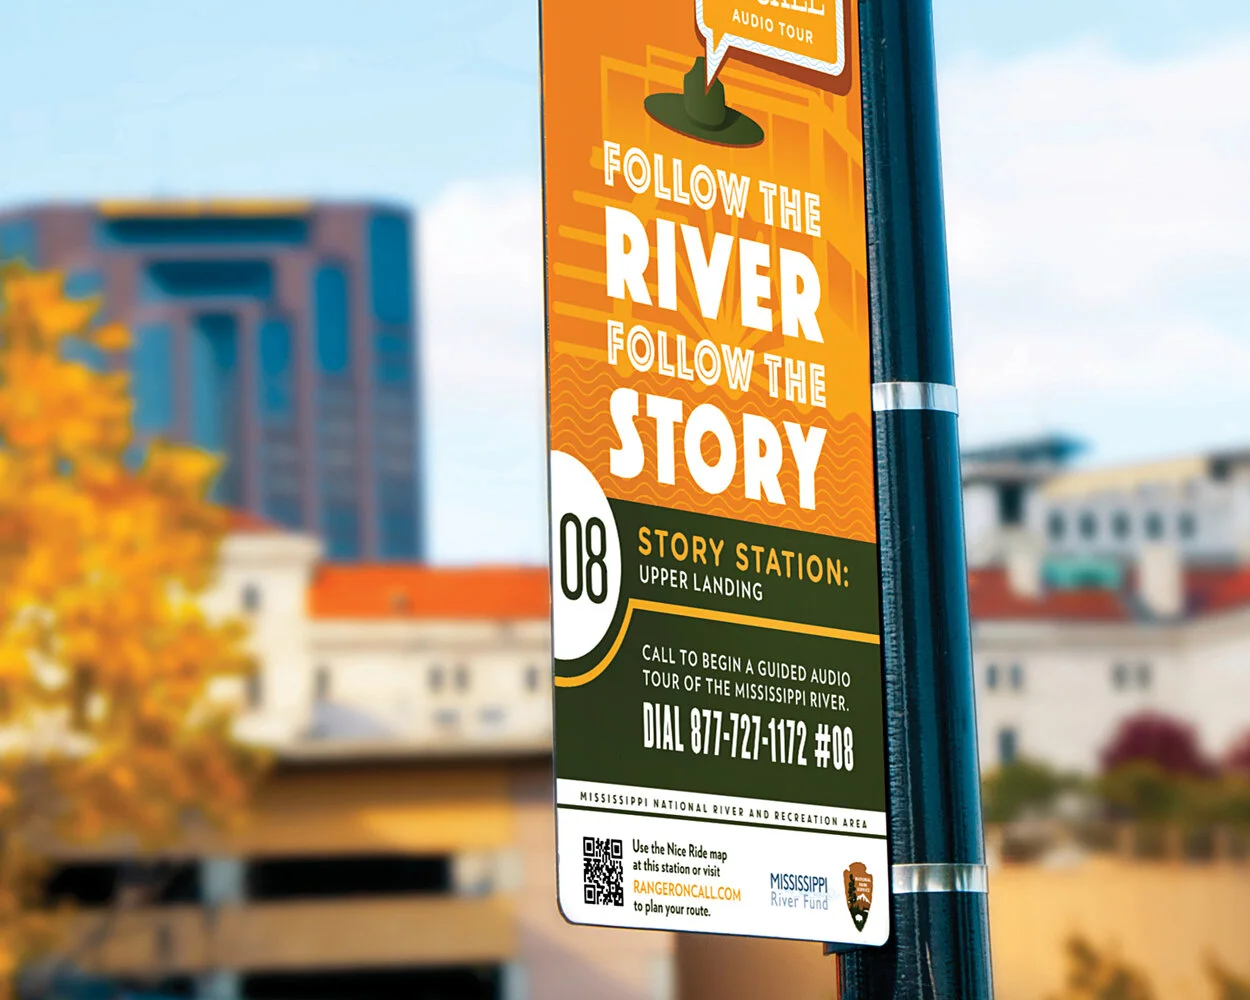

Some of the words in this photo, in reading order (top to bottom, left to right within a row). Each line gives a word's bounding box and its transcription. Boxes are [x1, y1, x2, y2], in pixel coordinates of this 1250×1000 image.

[732, 7, 774, 33] AUDIO
[779, 20, 814, 45] TOUR
[603, 139, 750, 219] FOLLOW
[759, 180, 821, 238] THE
[605, 205, 824, 343] RIVER
[607, 319, 755, 393] FOLLOW
[764, 353, 827, 409] THE
[609, 386, 827, 511] STORY
[559, 512, 608, 605] 08
[638, 526, 725, 567] STORY
[736, 542, 849, 588] STATION:
[639, 564, 688, 590] UPPER
[693, 573, 763, 601] LANDING
[642, 644, 676, 664] CALL
[679, 649, 697, 667] TO
[702, 652, 741, 673] BEGIN
[745, 659, 754, 675] A
[757, 660, 807, 682] GUIDED
[810, 668, 850, 688] AUDIO
[642, 669, 680, 690] TOUR
[684, 675, 702, 692] OF
[705, 677, 730, 697] THE
[735, 681, 806, 706] MISSISSIPPI
[810, 691, 850, 711] RIVER.
[643, 701, 684, 752] DIAL
[690, 707, 807, 766] 877-727-1172
[814, 723, 854, 771] #08
[580, 791, 647, 807] MISSISSIPPI
[654, 799, 708, 813] NATIONAL
[713, 805, 744, 816] RIVER
[749, 808, 769, 819] AND
[775, 811, 838, 826] RECREATION
[843, 818, 867, 828] AREA
[632, 838, 649, 854] Use
[651, 840, 665, 855] the
[667, 842, 686, 857] Nice
[689, 844, 707, 859] Ride
[710, 850, 728, 864] map
[633, 860, 641, 871] at
[643, 858, 659, 872] this
[661, 862, 690, 874] station
[692, 866, 701, 875] or
[703, 865, 720, 877] visit
[633, 879, 741, 902] RANGERONCALL.COM
[770, 873, 828, 893] MISSISSIPPI
[771, 891, 799, 908] River
[804, 894, 828, 910] Fund
[633, 901, 643, 912] to
[645, 898, 663, 916] plan
[665, 905, 684, 917] your
[686, 906, 711, 917] route.
